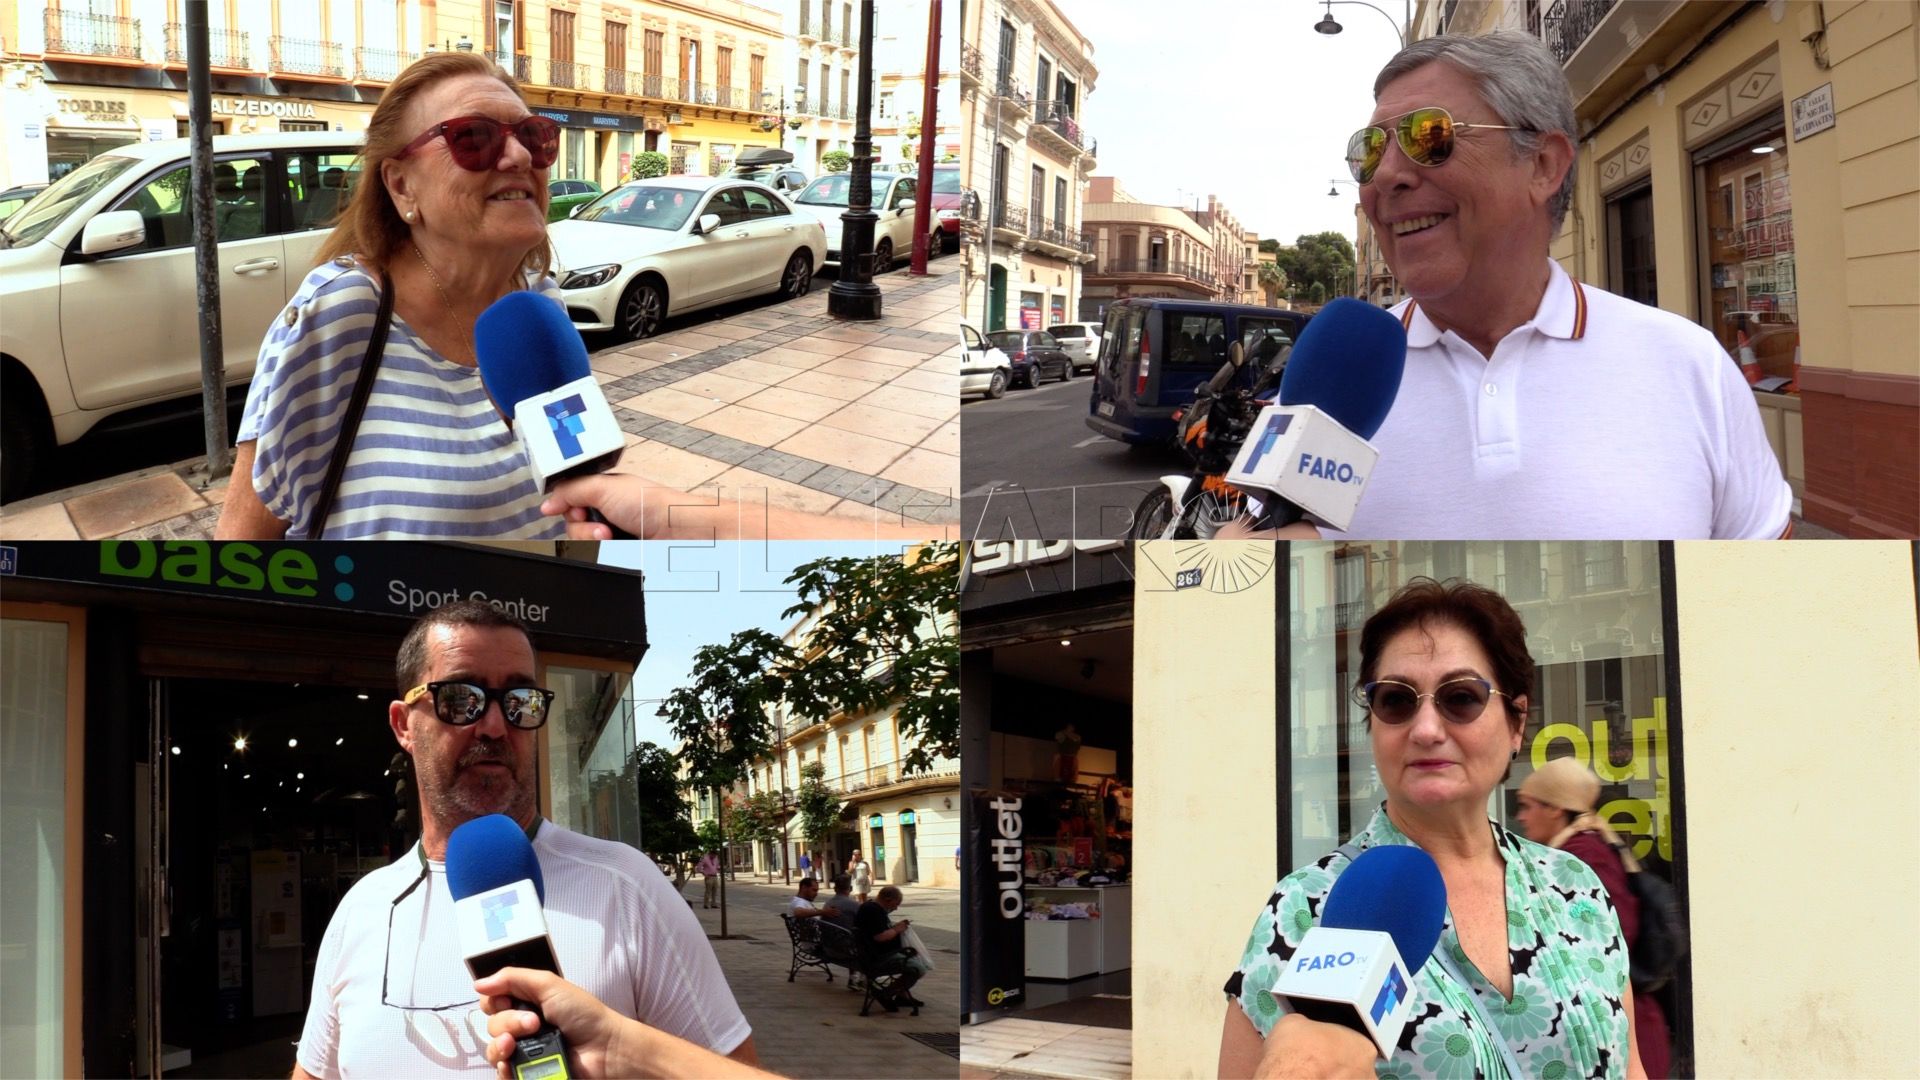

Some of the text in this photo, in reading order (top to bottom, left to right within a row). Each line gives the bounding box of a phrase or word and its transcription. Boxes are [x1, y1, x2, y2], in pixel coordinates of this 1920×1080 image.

[57, 98, 126, 114] TORRES
[211, 98, 316, 118] ALZEDONIA
[1298, 453, 1353, 483] FARO
[388, 579, 460, 612] Sport
[990, 796, 1023, 919] outlet
[1296, 951, 1356, 973] FARO
